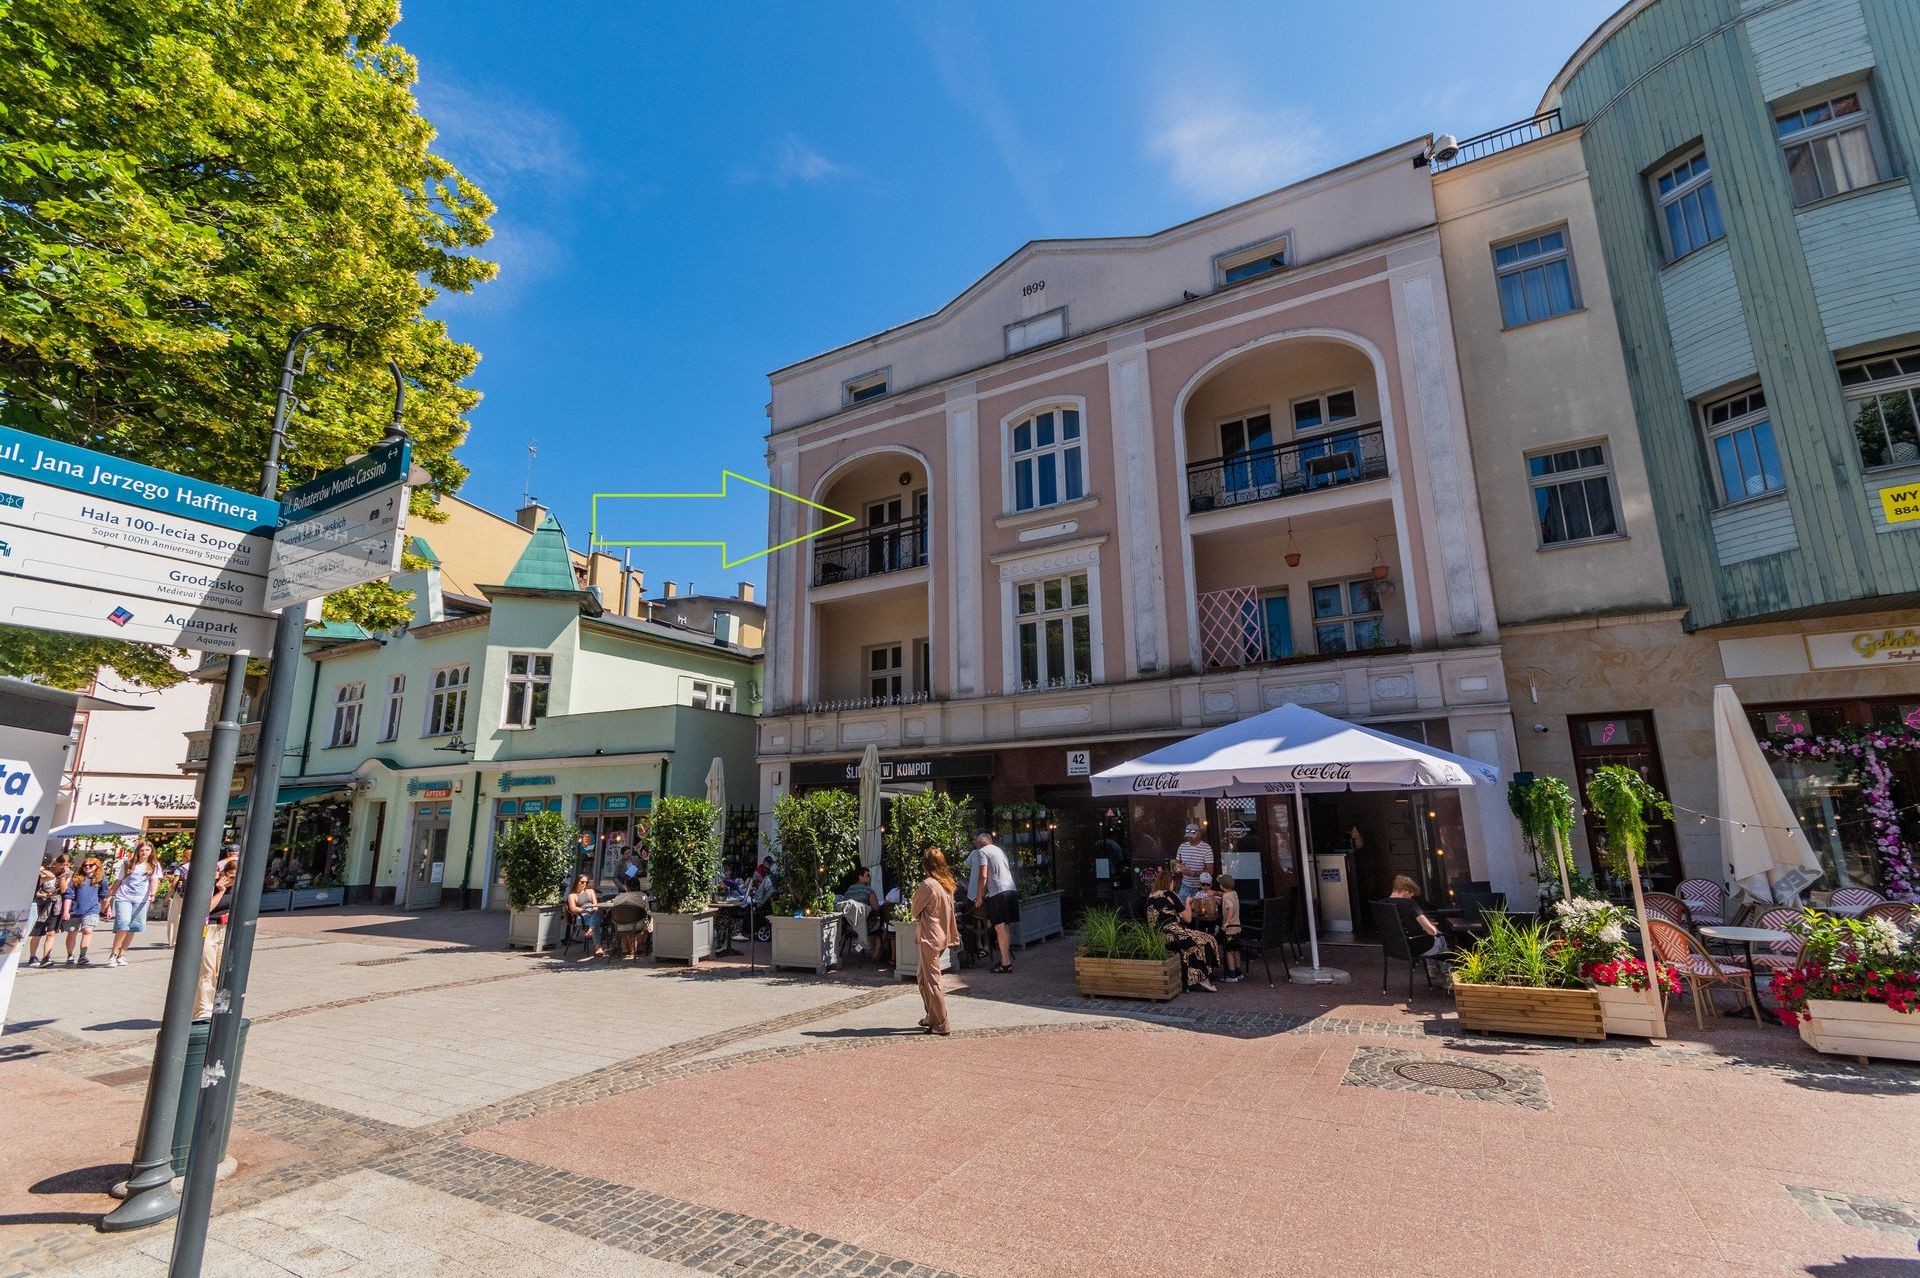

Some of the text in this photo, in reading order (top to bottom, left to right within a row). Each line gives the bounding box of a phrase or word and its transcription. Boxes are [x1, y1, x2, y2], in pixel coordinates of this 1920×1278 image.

[1022, 280, 1045, 296] 1899
[0, 443, 258, 522] ul. Jana Jerzego Haffnera
[293, 485, 331, 511] Bohaterów
[331, 474, 355, 496] Monte
[356, 462, 387, 485] Cassino
[1890, 490, 1918, 502] WY
[1894, 505, 1920, 515] 884
[81, 506, 251, 555] Hala 100-lecia Sopotu
[92, 527, 250, 567] Sopot 100th Anniversary Sports Hall
[169, 570, 244, 593] Grodzisko
[157, 585, 242, 606] Medieval Stronghold
[164, 614, 238, 634] Aquapark
[196, 635, 236, 648] Aquapark
[1072, 753, 1085, 765] 42
[896, 762, 932, 777] KOMPOT
[425, 790, 446, 798] APTEKA
